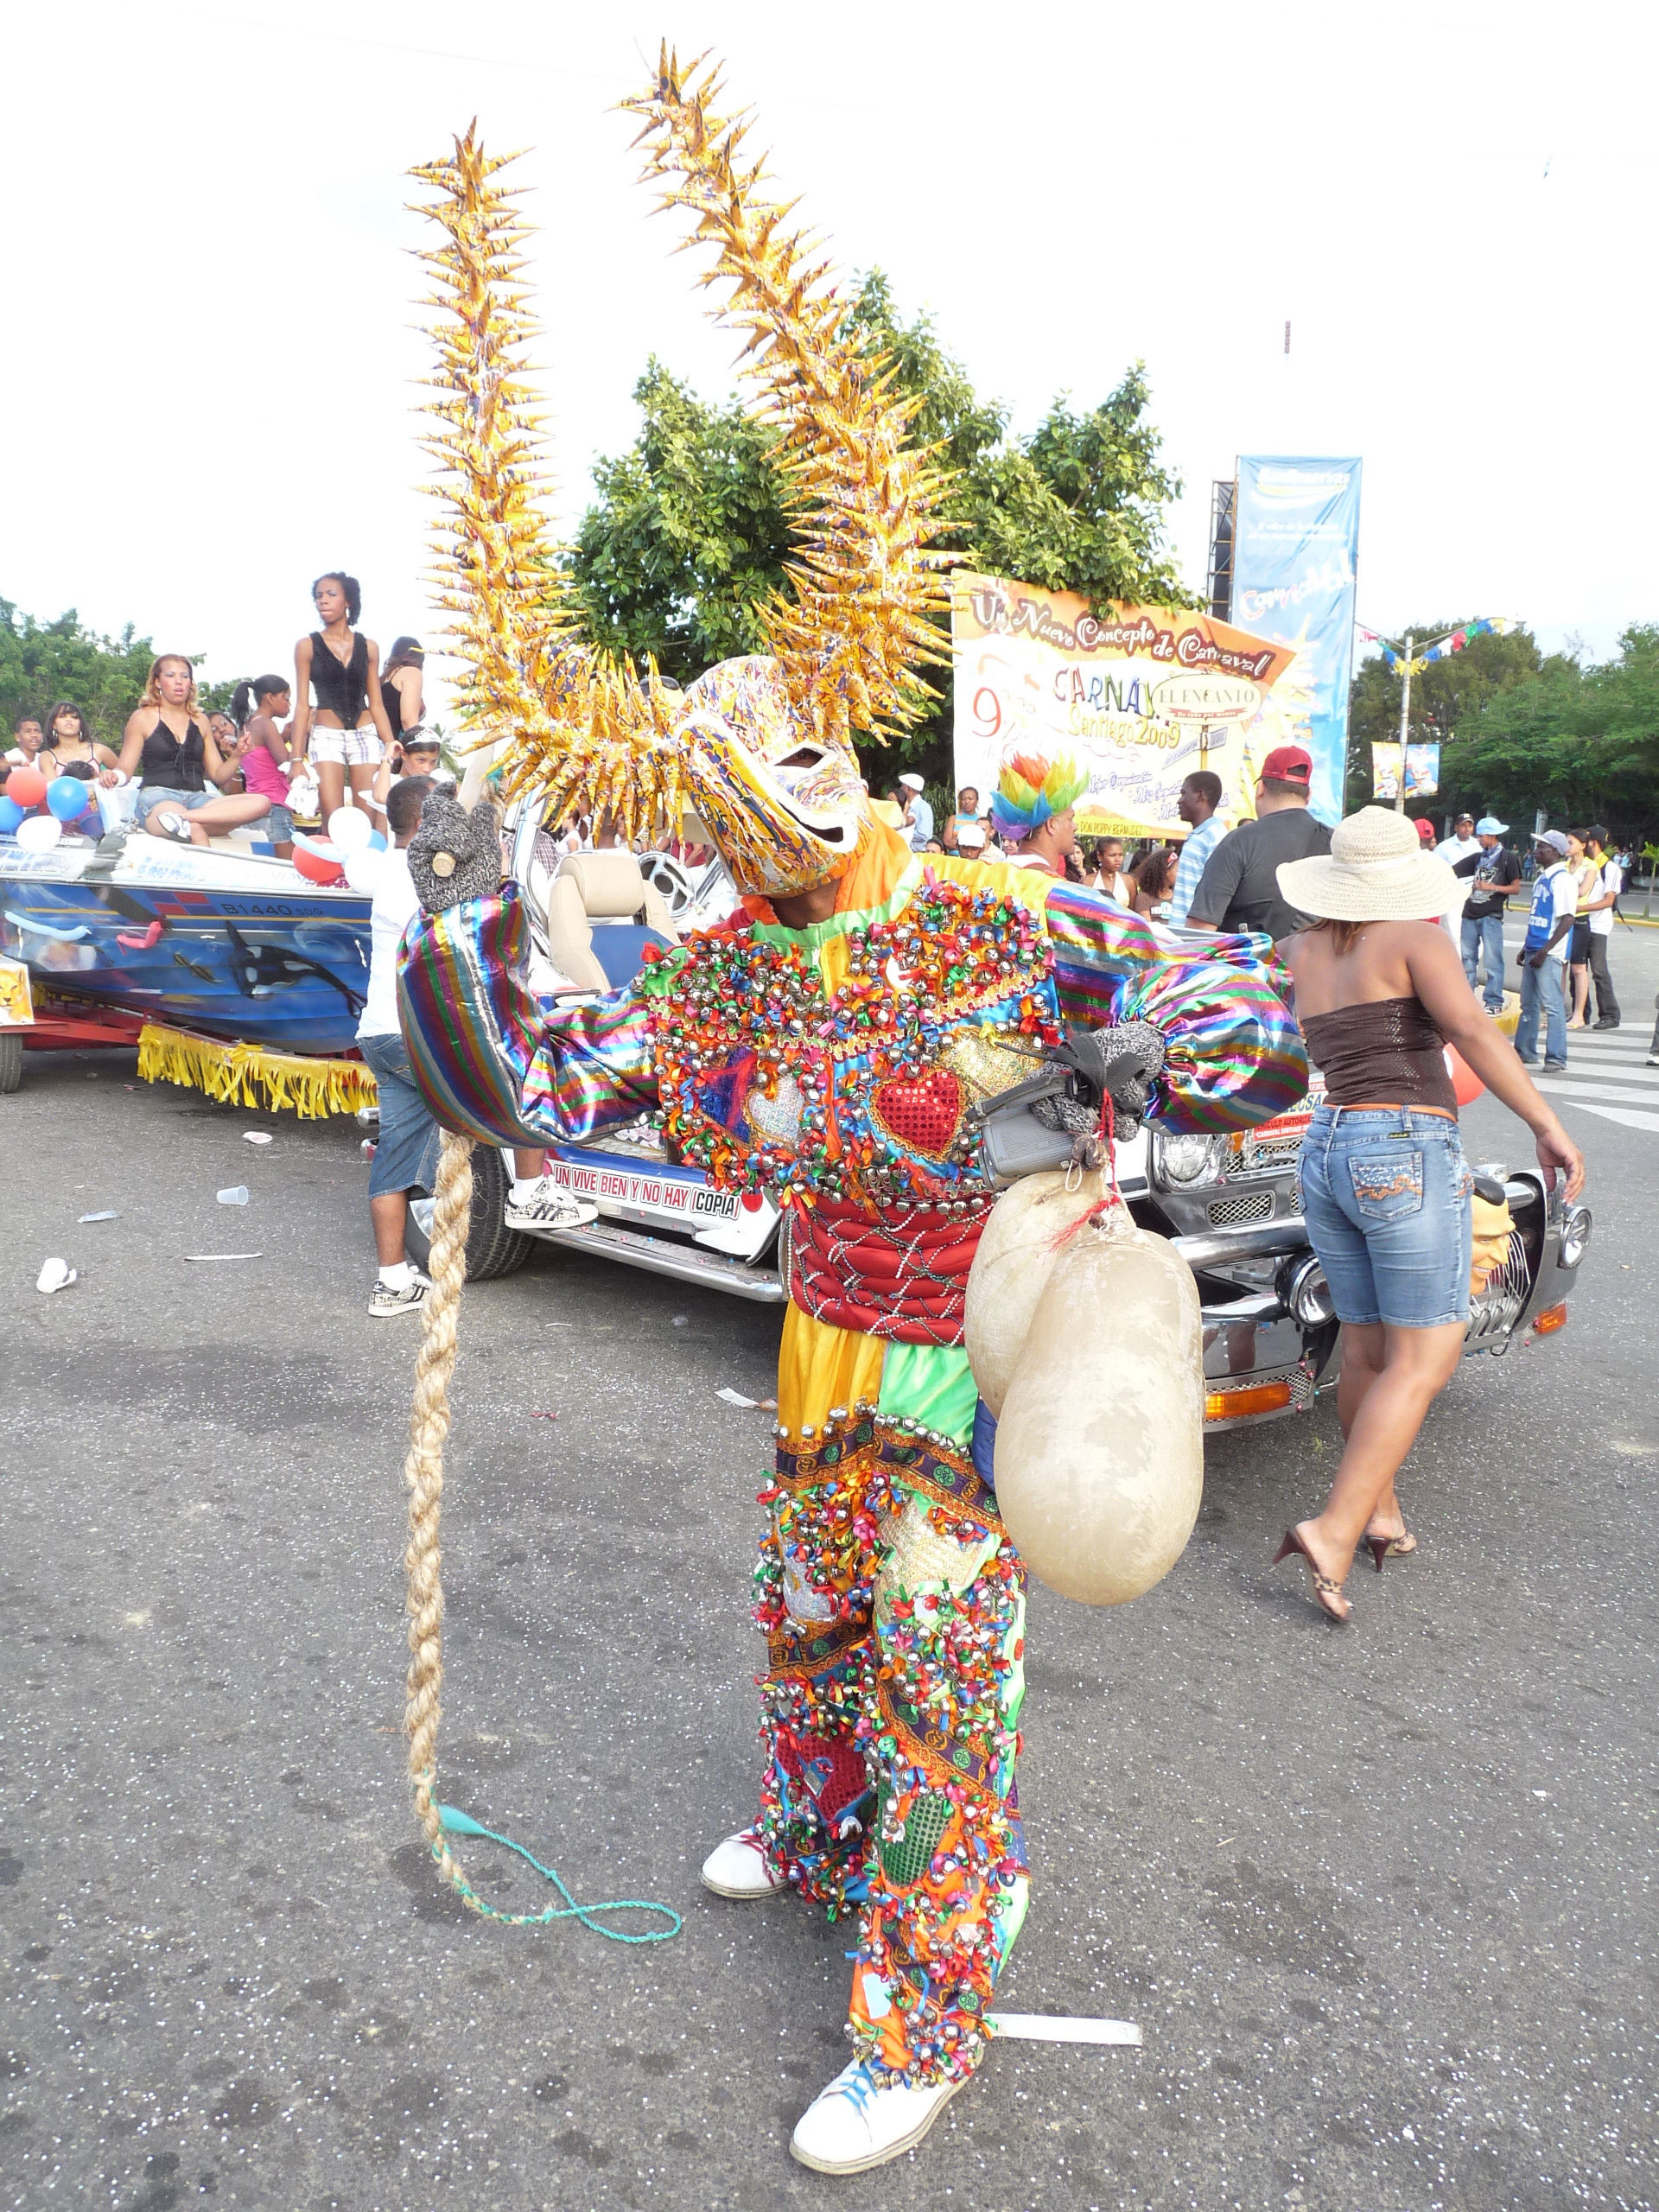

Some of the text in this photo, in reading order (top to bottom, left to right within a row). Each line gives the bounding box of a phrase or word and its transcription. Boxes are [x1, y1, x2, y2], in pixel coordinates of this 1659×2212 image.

[972, 595, 1006, 625] Un
[1014, 602, 1074, 647] Nuevo
[1077, 616, 1155, 652] Concepto
[1153, 634, 1173, 658] de
[972, 687, 1001, 737] 9
[1160, 689, 1255, 703] EL ENCANTO
[1068, 702, 1180, 749] Santiago 2009
[1080, 821, 1093, 833] DON
[221, 903, 292, 916] B1440
[555, 1166, 570, 1186] UN
[573, 1169, 597, 1192] VIVE
[601, 1173, 627, 1198] BIEN
[631, 1179, 639, 1199] Y
[642, 1182, 661, 1203] NO
[664, 1185, 690, 1209] HAY
